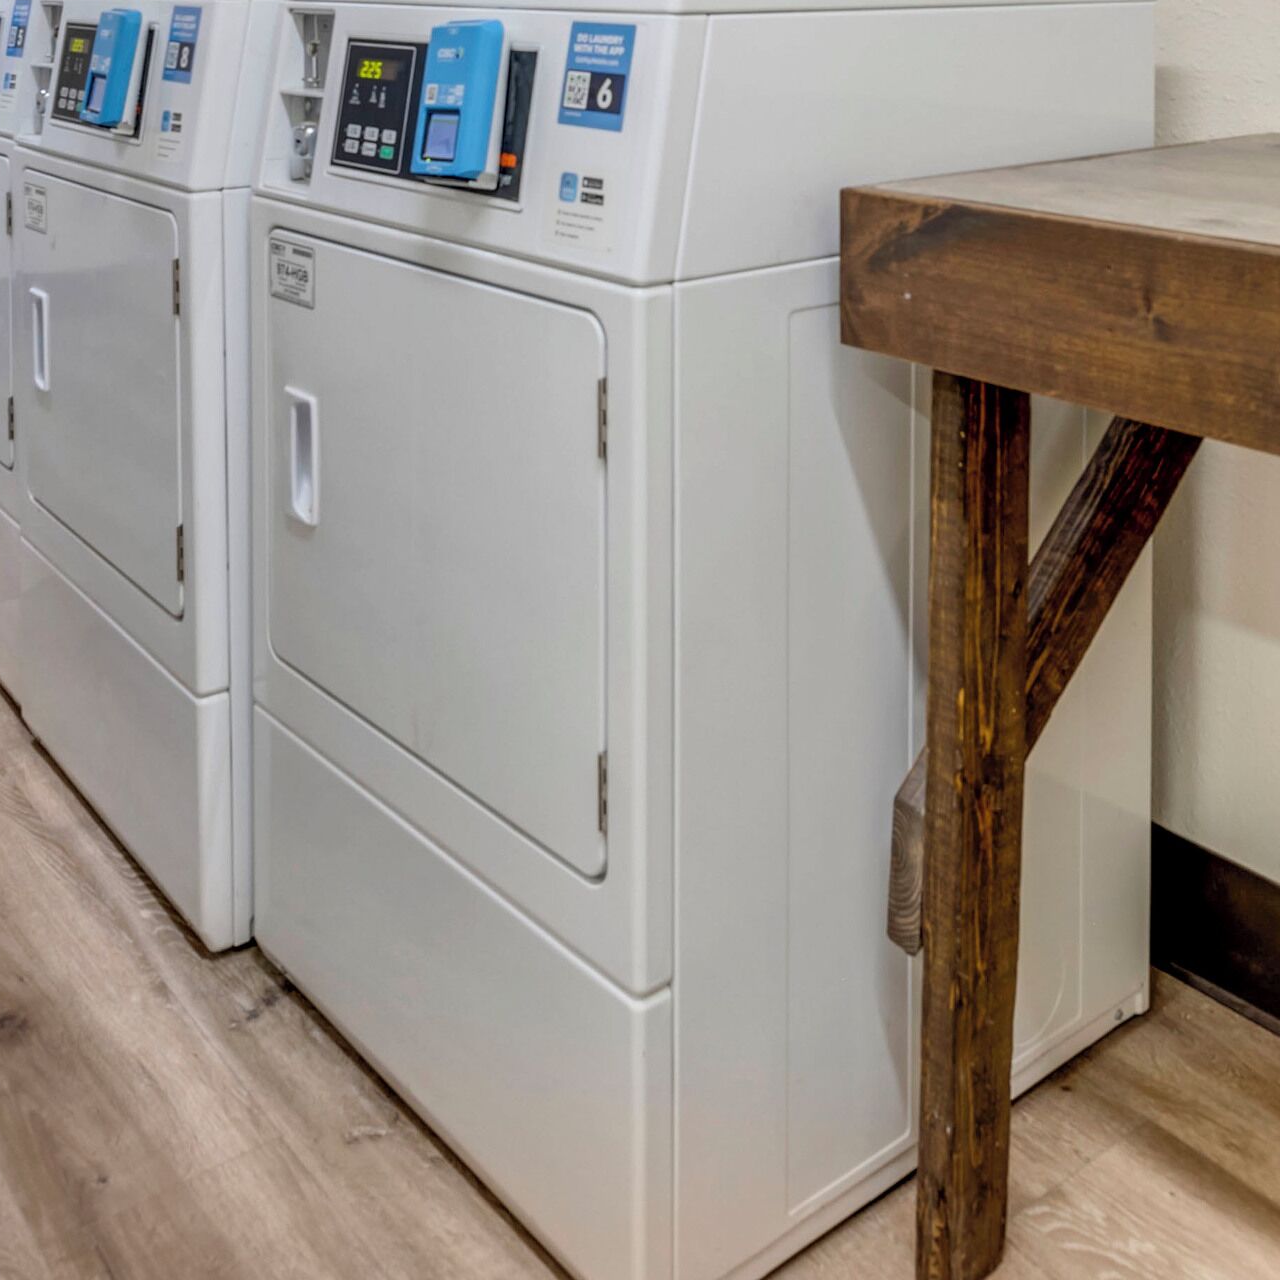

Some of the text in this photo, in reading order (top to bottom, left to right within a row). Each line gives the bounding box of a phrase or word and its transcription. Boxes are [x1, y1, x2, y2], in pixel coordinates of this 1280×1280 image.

[576, 33, 625, 45] DO LAUNDRY
[179, 45, 191, 69] 8
[573, 43, 626, 56] WITH THE APP
[358, 60, 384, 80] 225
[596, 77, 614, 110] 6
